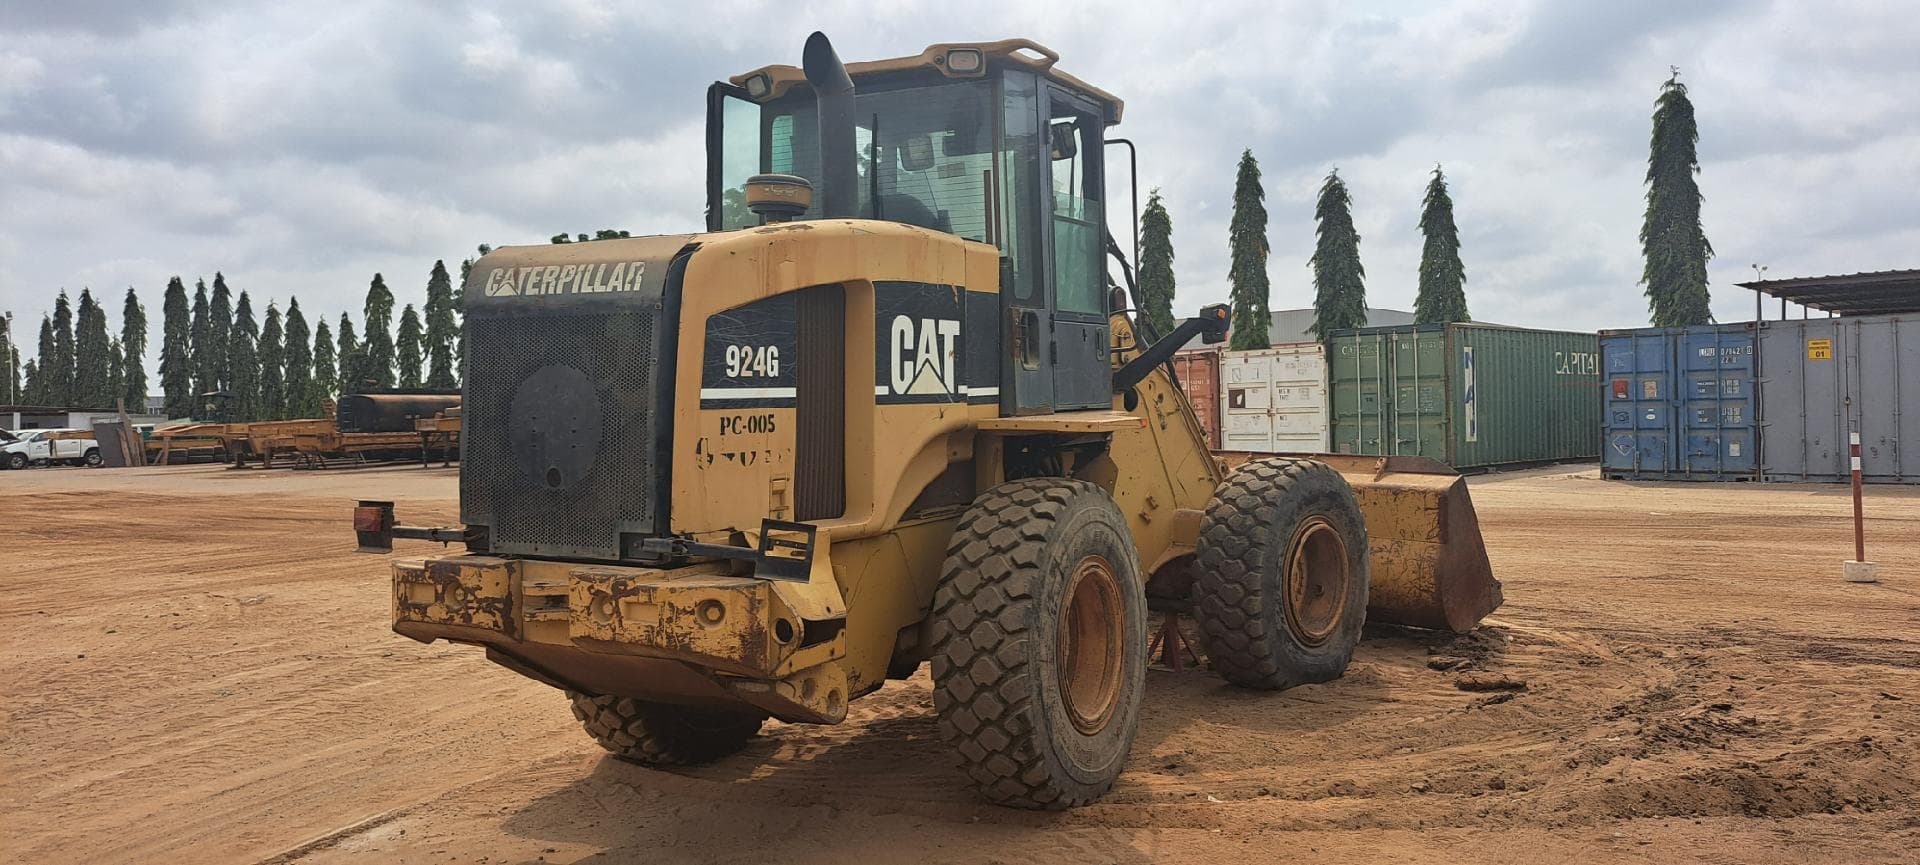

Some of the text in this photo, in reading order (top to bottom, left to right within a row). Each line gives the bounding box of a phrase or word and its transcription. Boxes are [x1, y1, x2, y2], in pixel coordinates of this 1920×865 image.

[485, 261, 645, 297] CATERPILLAR
[725, 344, 779, 378] 924G
[891, 314, 960, 395] CAT
[1815, 350, 1825, 358] 01
[720, 413, 776, 436] PC-005
